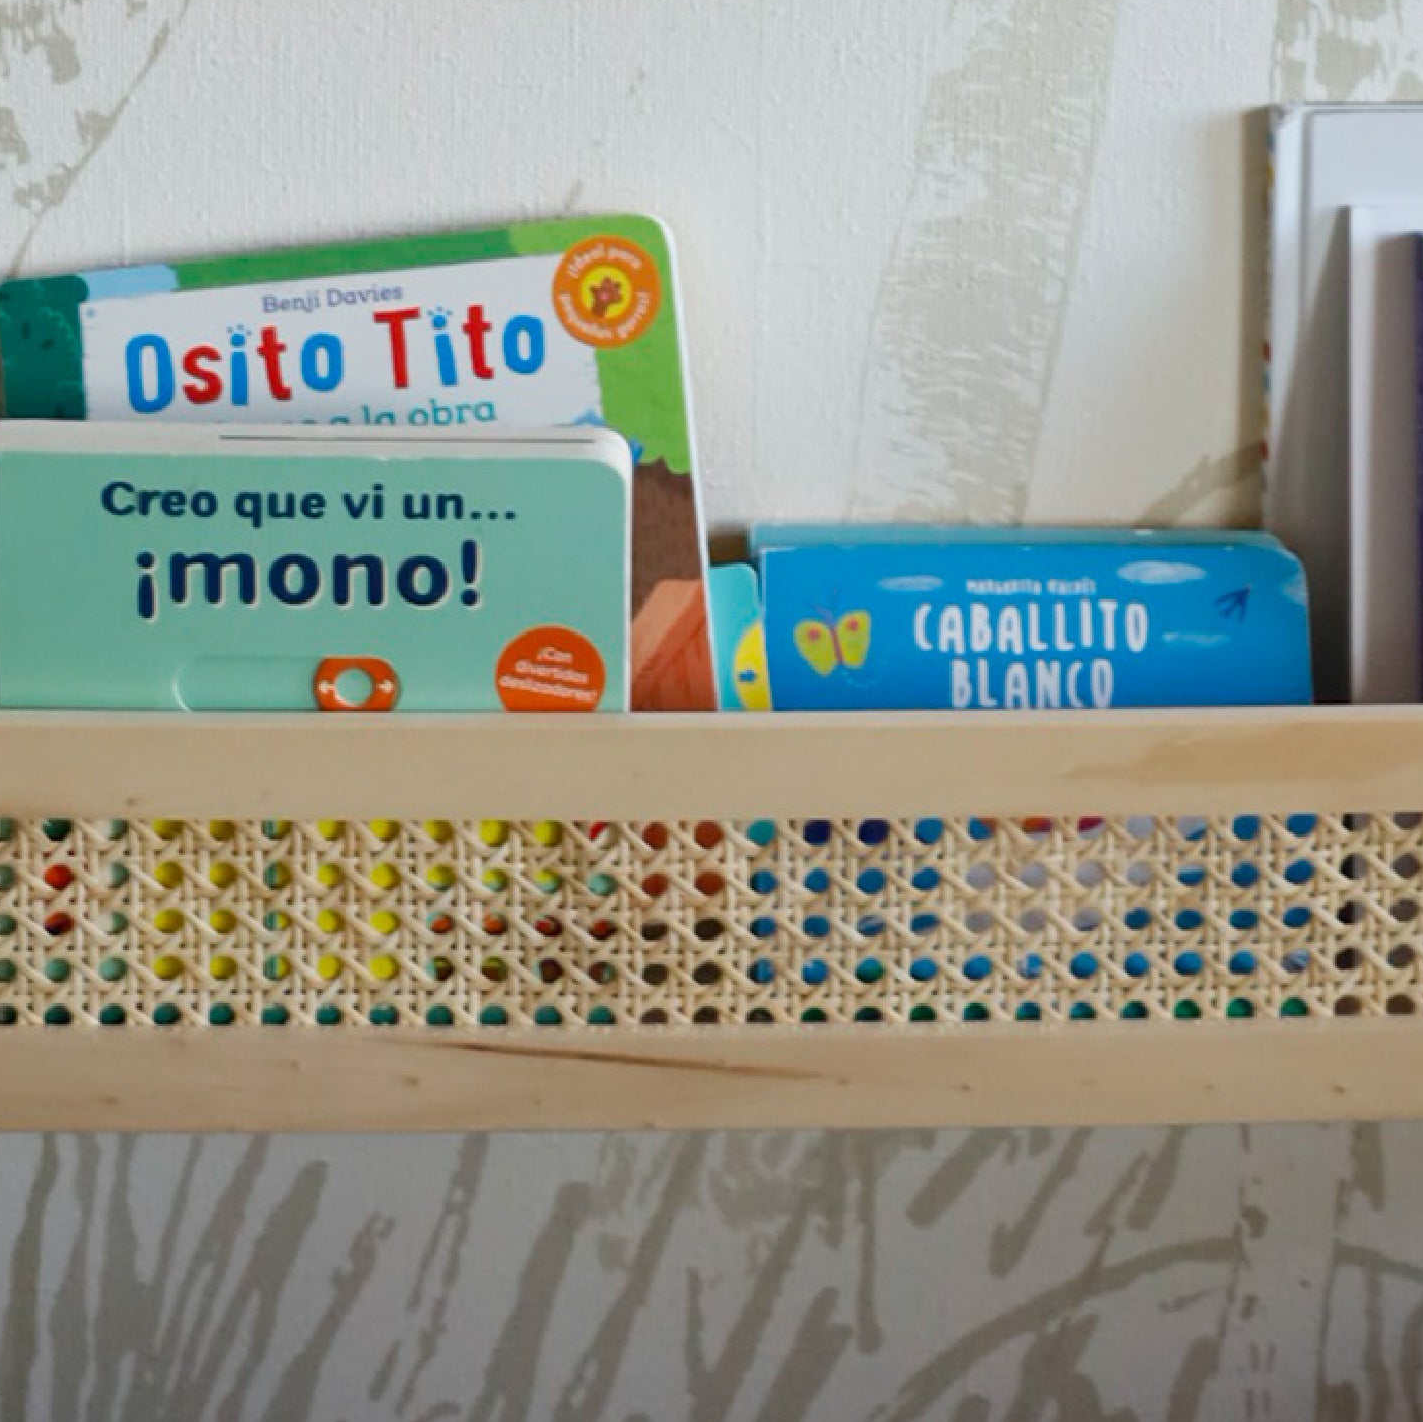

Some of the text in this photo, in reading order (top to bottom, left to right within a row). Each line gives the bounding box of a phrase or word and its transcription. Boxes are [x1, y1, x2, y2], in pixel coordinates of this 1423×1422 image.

[261, 284, 404, 313] Benji Davies
[124, 303, 547, 414] Osito Tito
[407, 398, 497, 426] obra
[100, 480, 518, 529] Creo que vi un...
[136, 538, 481, 621] ¡mono!
[913, 598, 1150, 655] CABALLITO
[950, 657, 1115, 708] BLANCO
